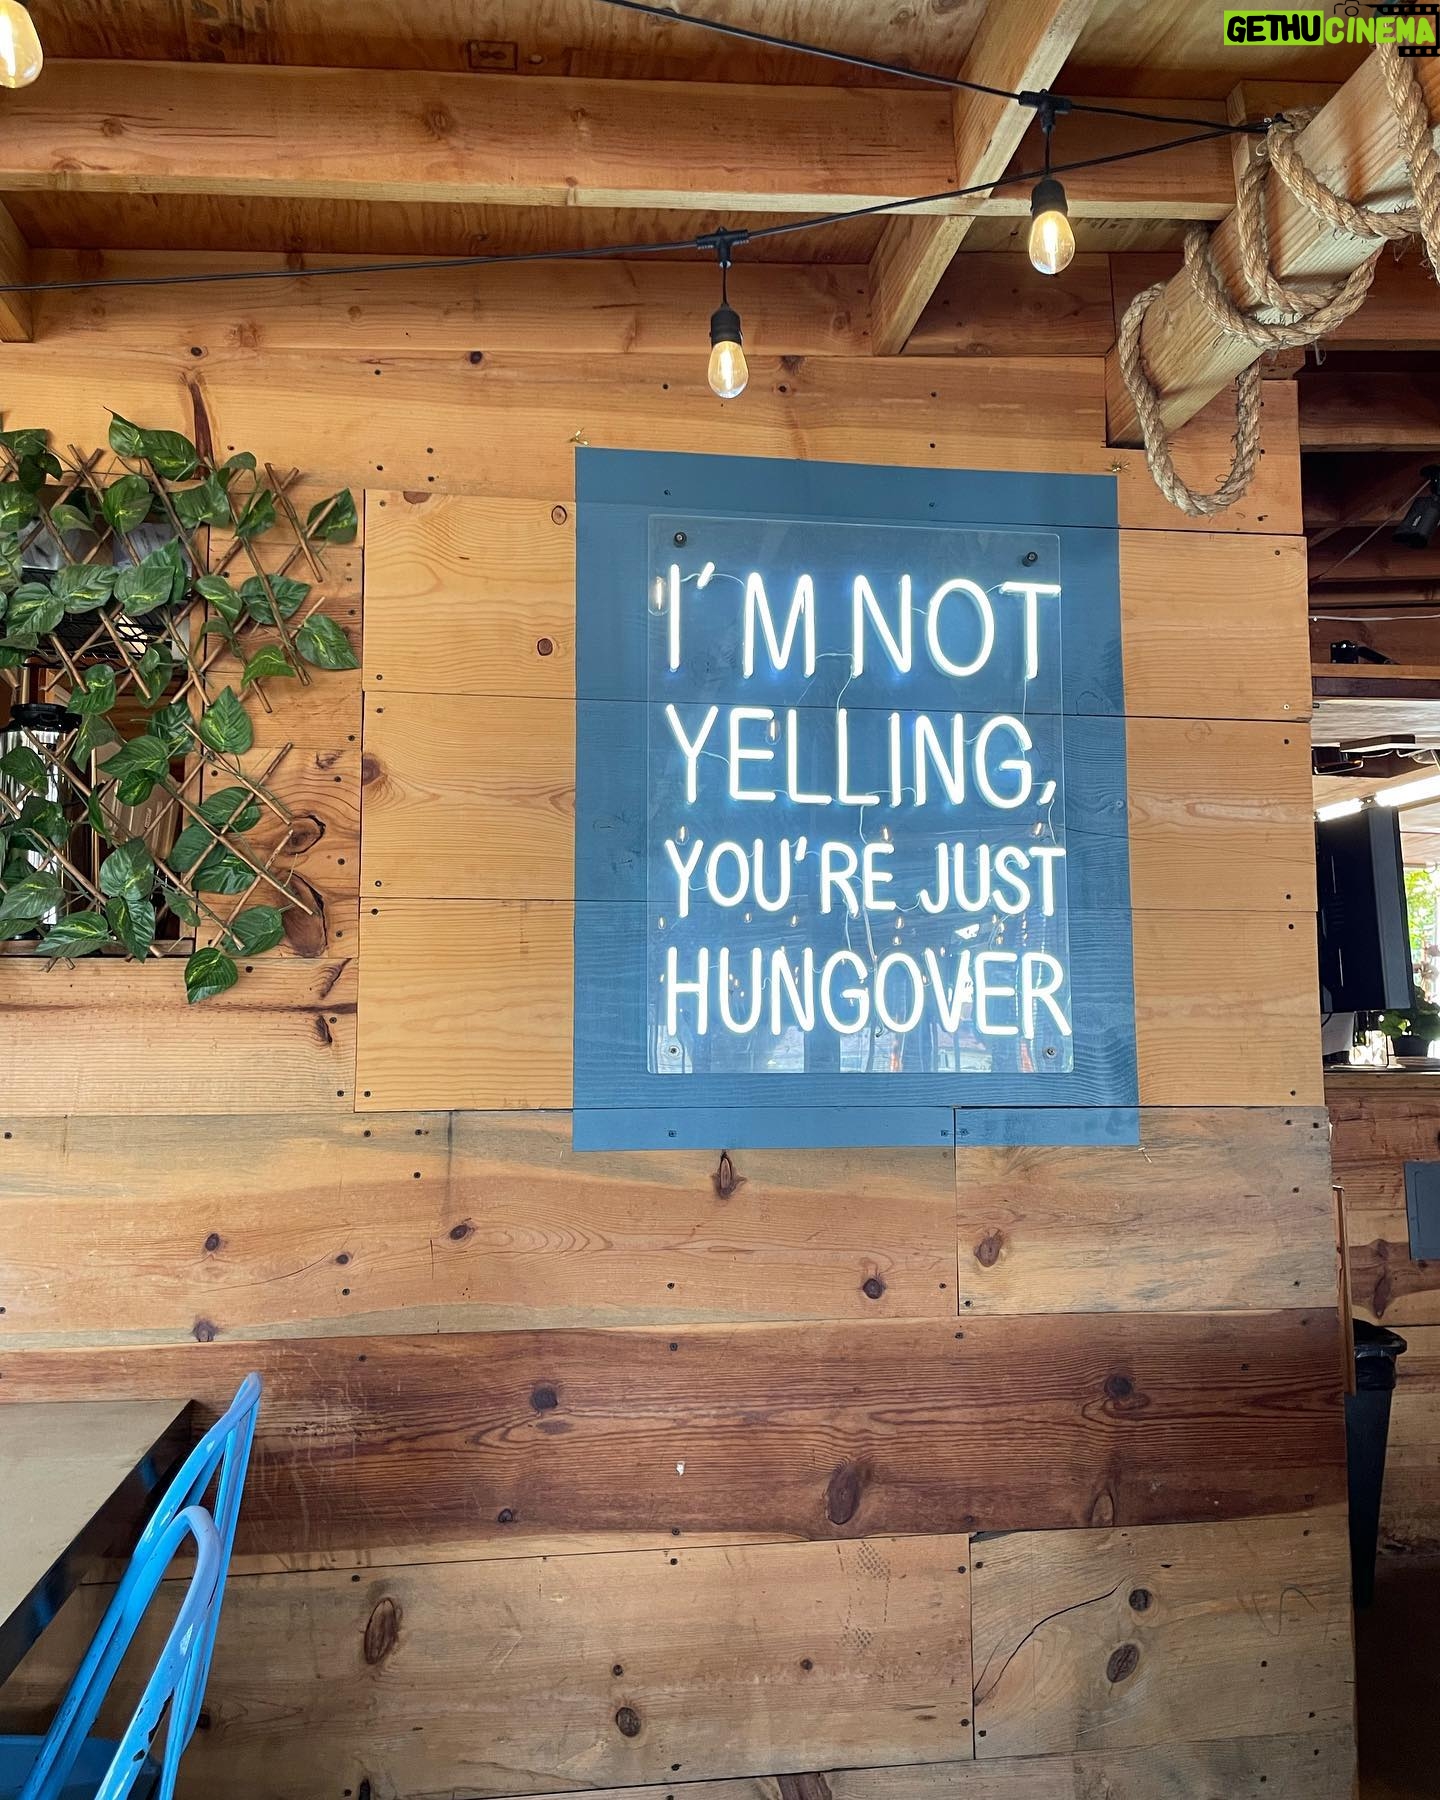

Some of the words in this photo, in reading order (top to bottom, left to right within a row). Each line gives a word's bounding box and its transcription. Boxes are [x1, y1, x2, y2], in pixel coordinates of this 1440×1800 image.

[852, 573, 1062, 680] NOT
[665, 703, 1057, 809] YELLING,
[664, 836, 896, 917] YOU'RE
[919, 843, 1067, 917] JUST
[667, 946, 1073, 1038] HUNGOVER
